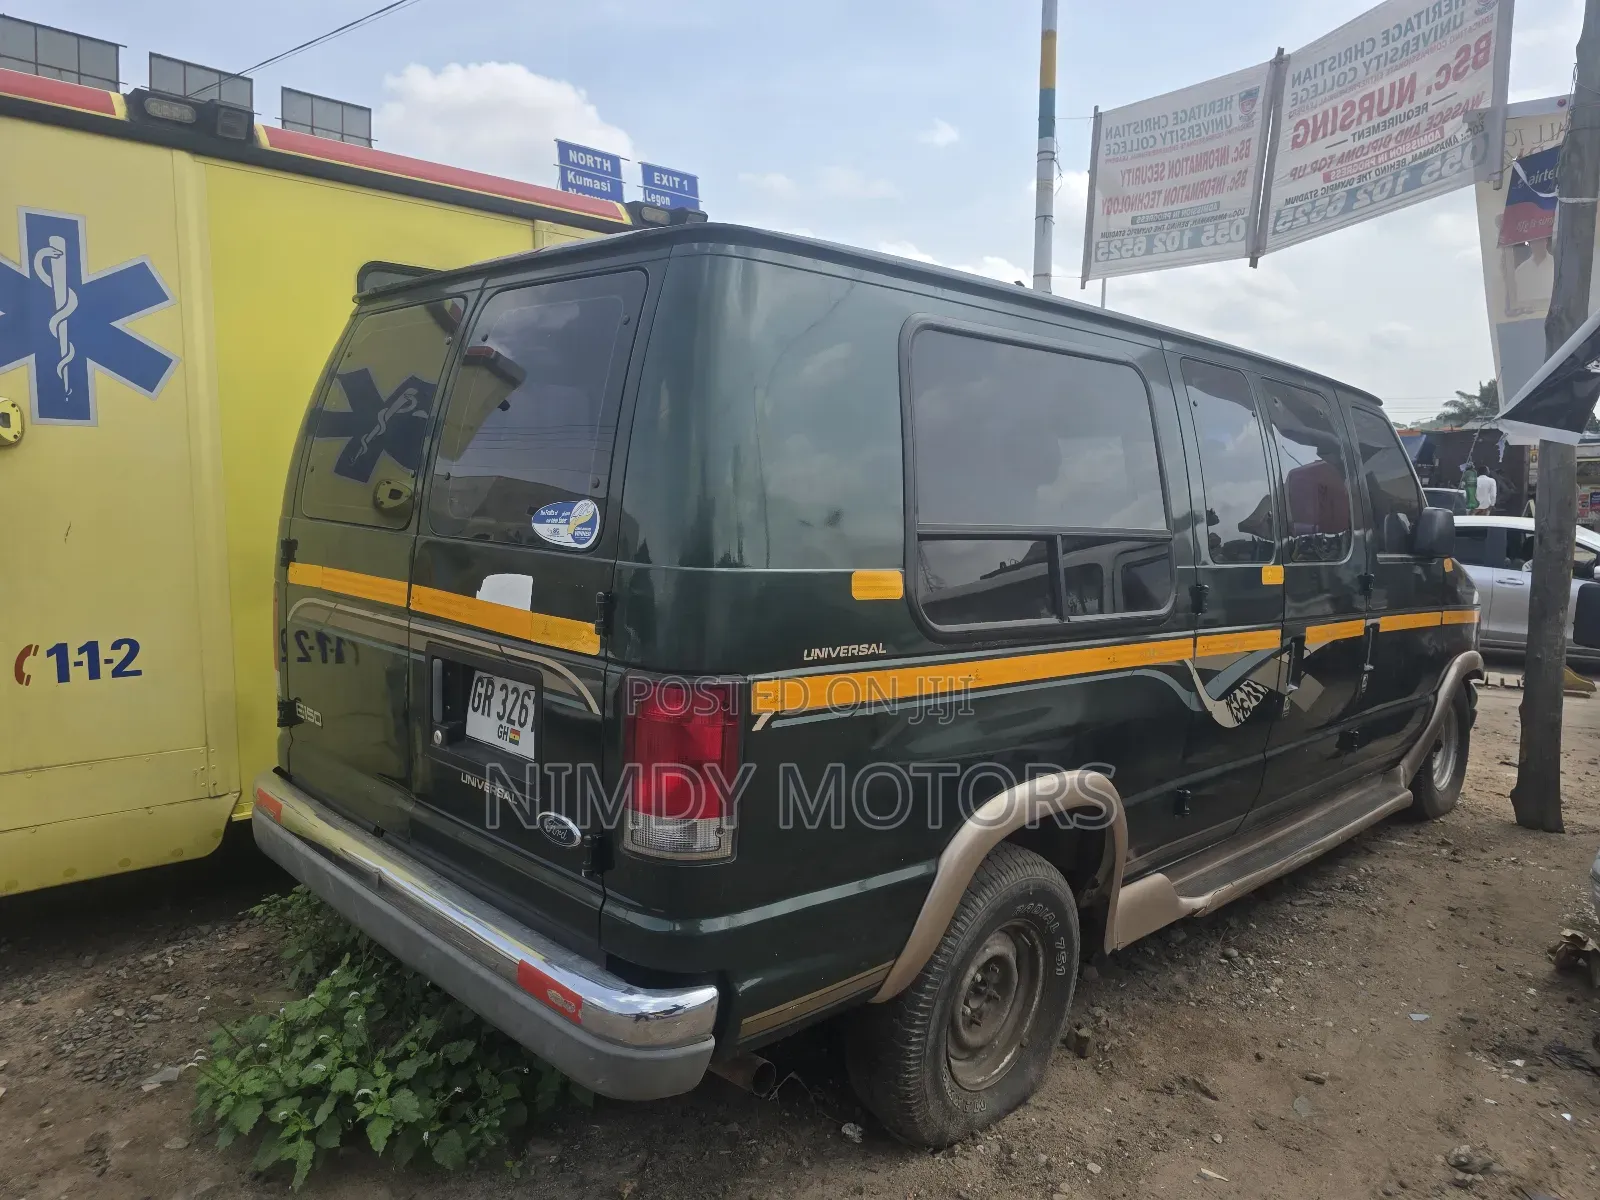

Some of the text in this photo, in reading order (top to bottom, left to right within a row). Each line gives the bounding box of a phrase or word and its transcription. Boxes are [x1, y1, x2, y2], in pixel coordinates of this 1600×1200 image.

[568, 149, 612, 172] NORTH
[567, 170, 611, 193] Kumasi
[653, 172, 689, 191] EXIT 1
[646, 189, 671, 206] Legon
[46, 637, 143, 684] 1-1-2
[803, 643, 887, 661] UNIVERSAL
[471, 675, 535, 733] GR 326
[497, 724, 510, 742] GH
[461, 772, 518, 805] UNIVERSAL
[1012, 903, 1060, 934] RADIAL
